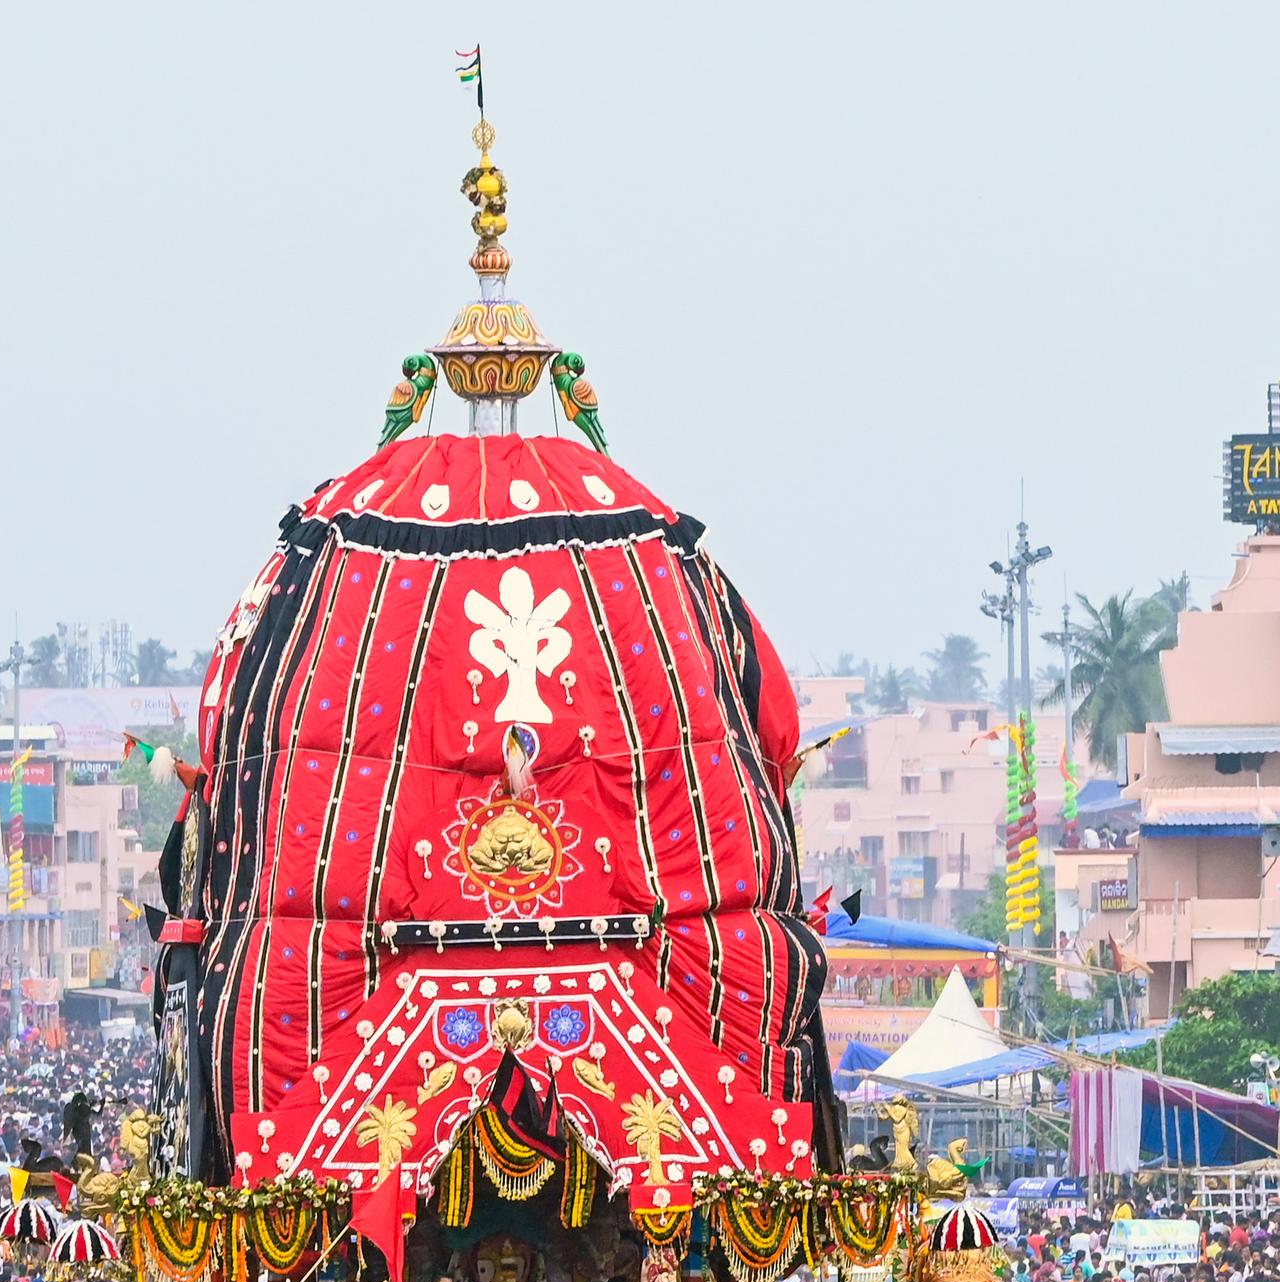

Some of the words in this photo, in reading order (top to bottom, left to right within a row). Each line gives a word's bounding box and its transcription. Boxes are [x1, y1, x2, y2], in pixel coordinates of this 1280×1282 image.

[1247, 500, 1257, 513] A
[1019, 1179, 1047, 1191] Amul
[1058, 1181, 1077, 1191] Amul
